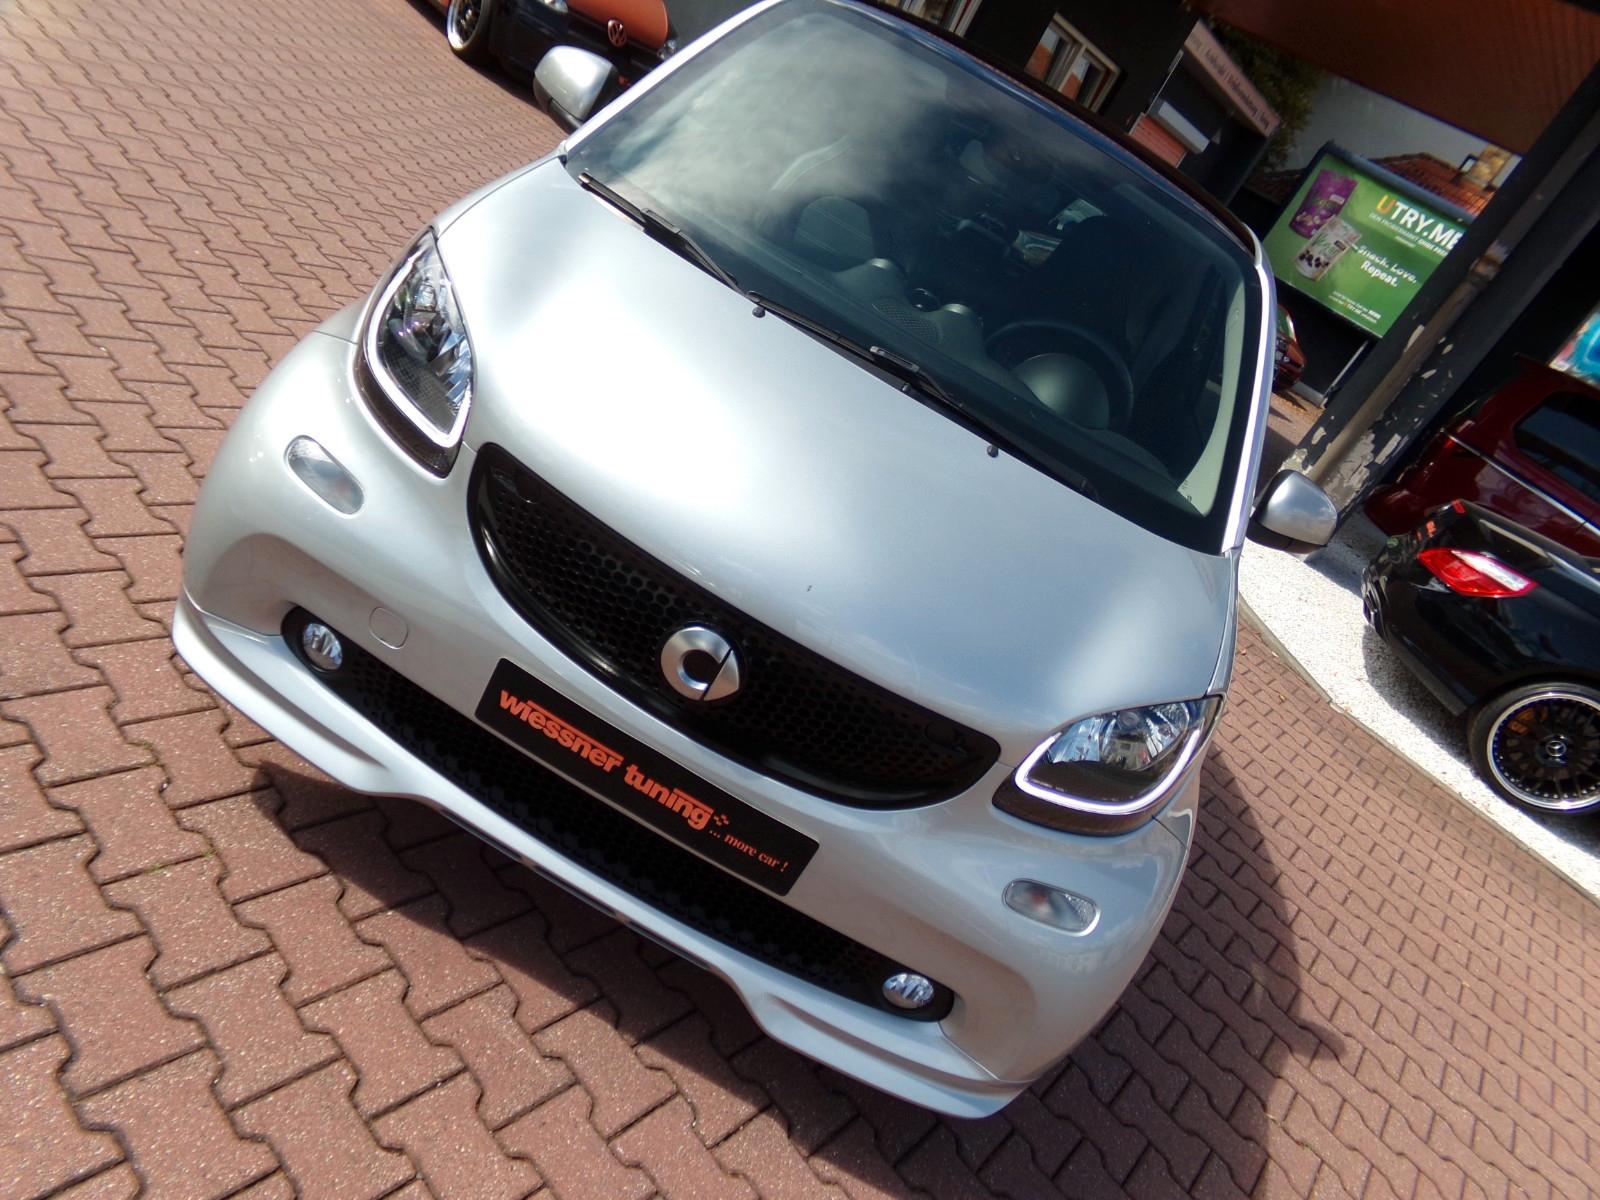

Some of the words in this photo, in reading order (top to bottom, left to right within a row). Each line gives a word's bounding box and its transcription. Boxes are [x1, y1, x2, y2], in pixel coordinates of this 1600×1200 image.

[499, 689, 624, 772] wiessner
[623, 764, 714, 830] tuning
[724, 834, 757, 857] more
[758, 852, 780, 868] car
